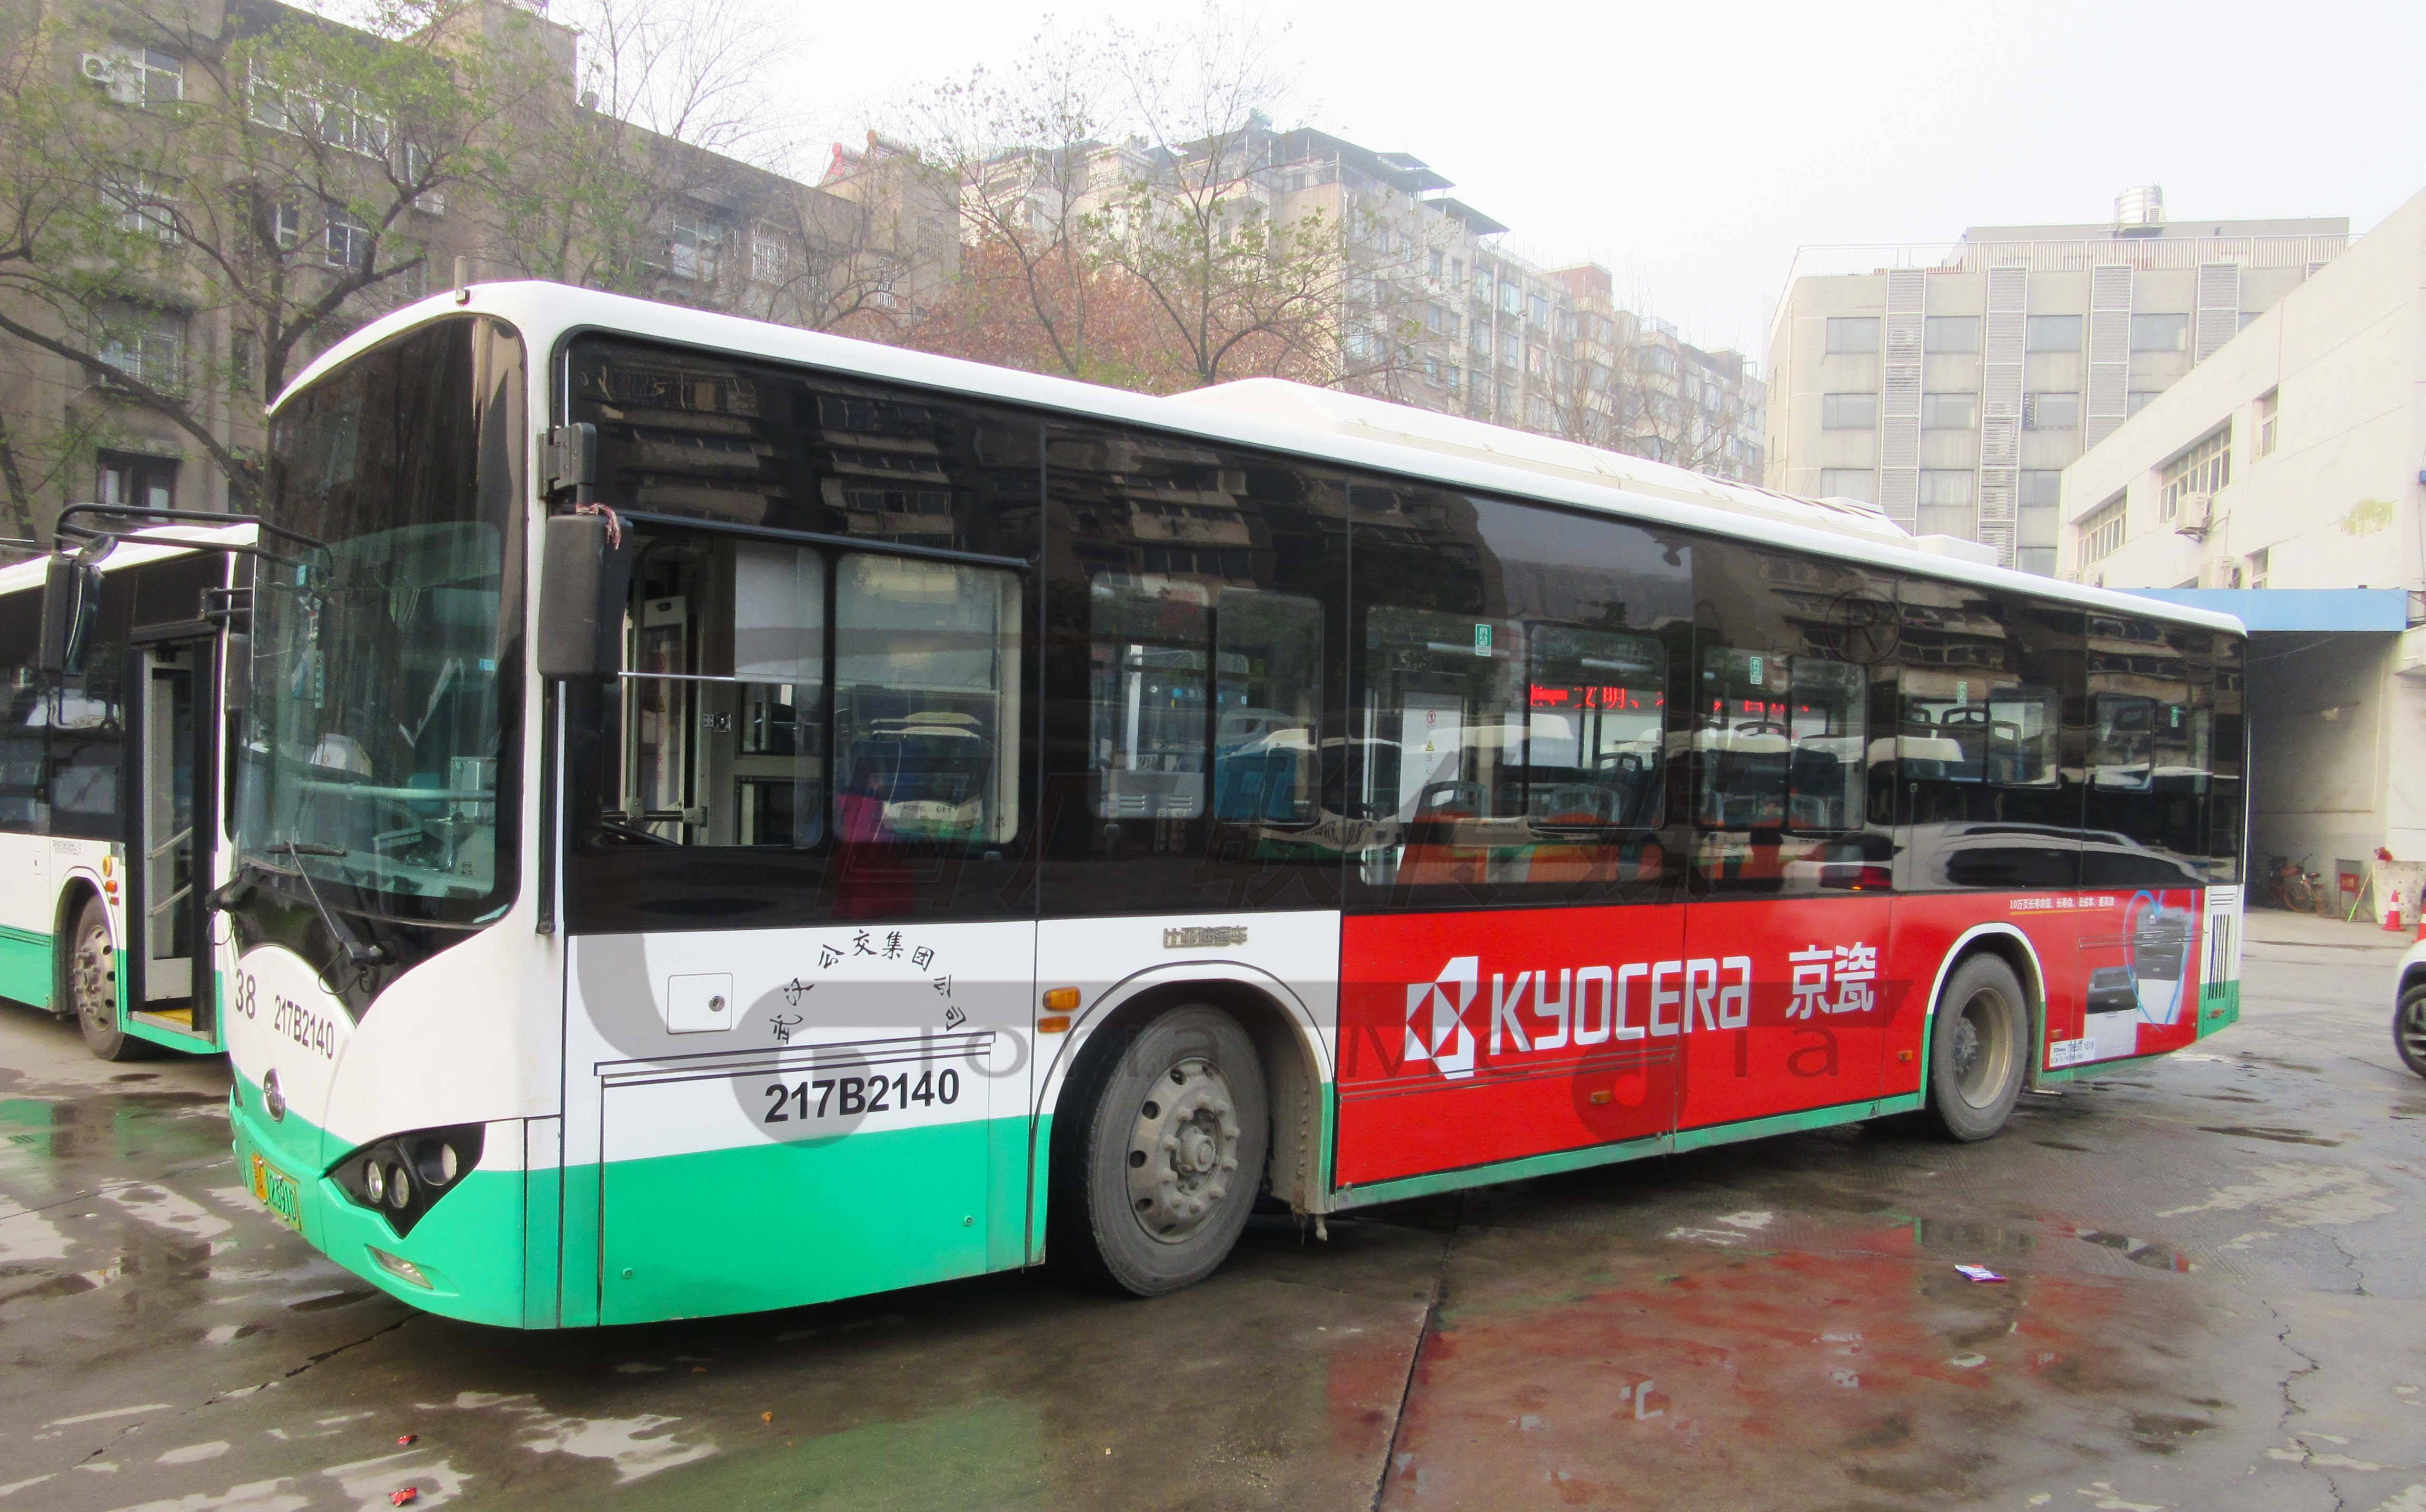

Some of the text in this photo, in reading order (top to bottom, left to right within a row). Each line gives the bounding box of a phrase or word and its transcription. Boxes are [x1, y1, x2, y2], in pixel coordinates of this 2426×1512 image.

[235, 968, 256, 1020] 38
[1489, 956, 1751, 1056] KYOCERA
[1786, 941, 1877, 1020] 京瓷
[274, 994, 334, 1060] 217B2140
[764, 1068, 960, 1124] 217B2140
